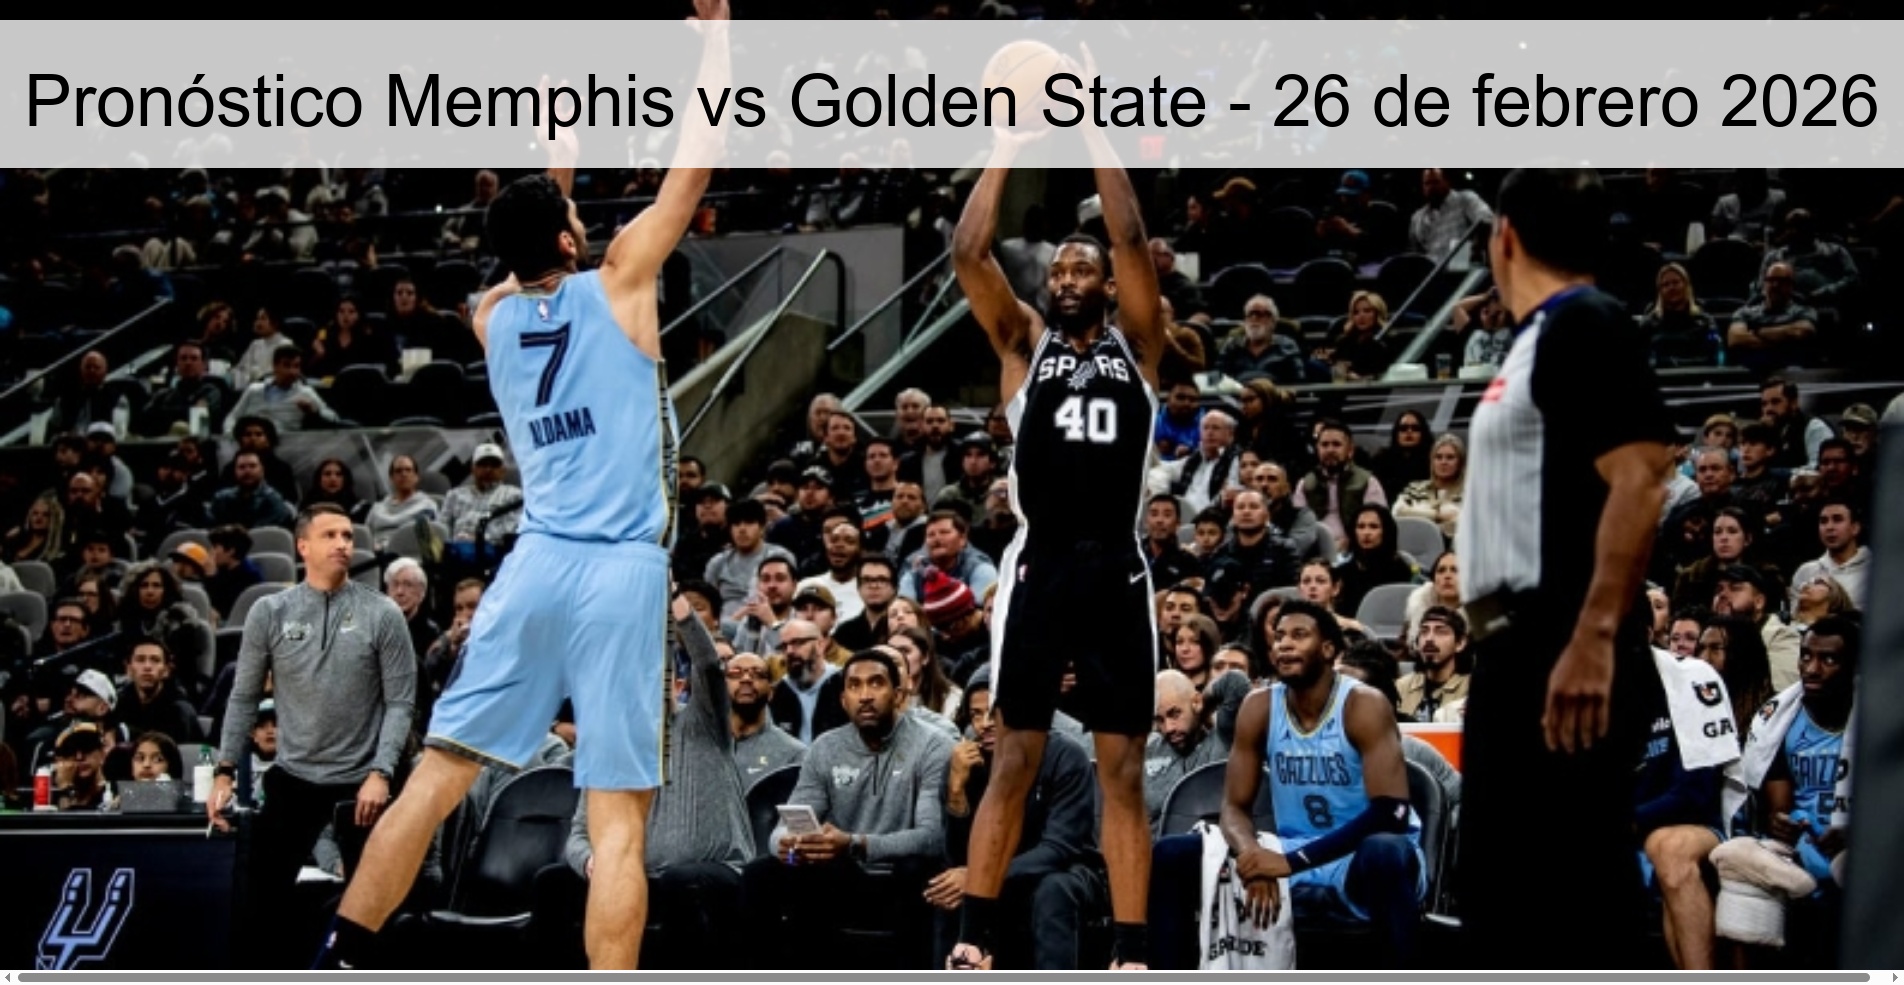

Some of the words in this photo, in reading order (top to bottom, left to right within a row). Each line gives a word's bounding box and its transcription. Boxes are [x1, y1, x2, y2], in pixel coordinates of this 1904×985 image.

[518, 320, 571, 408] 7
[1054, 395, 1118, 443] 40
[1275, 751, 1352, 786] GRZZLIES
[1303, 795, 1335, 830] 8
